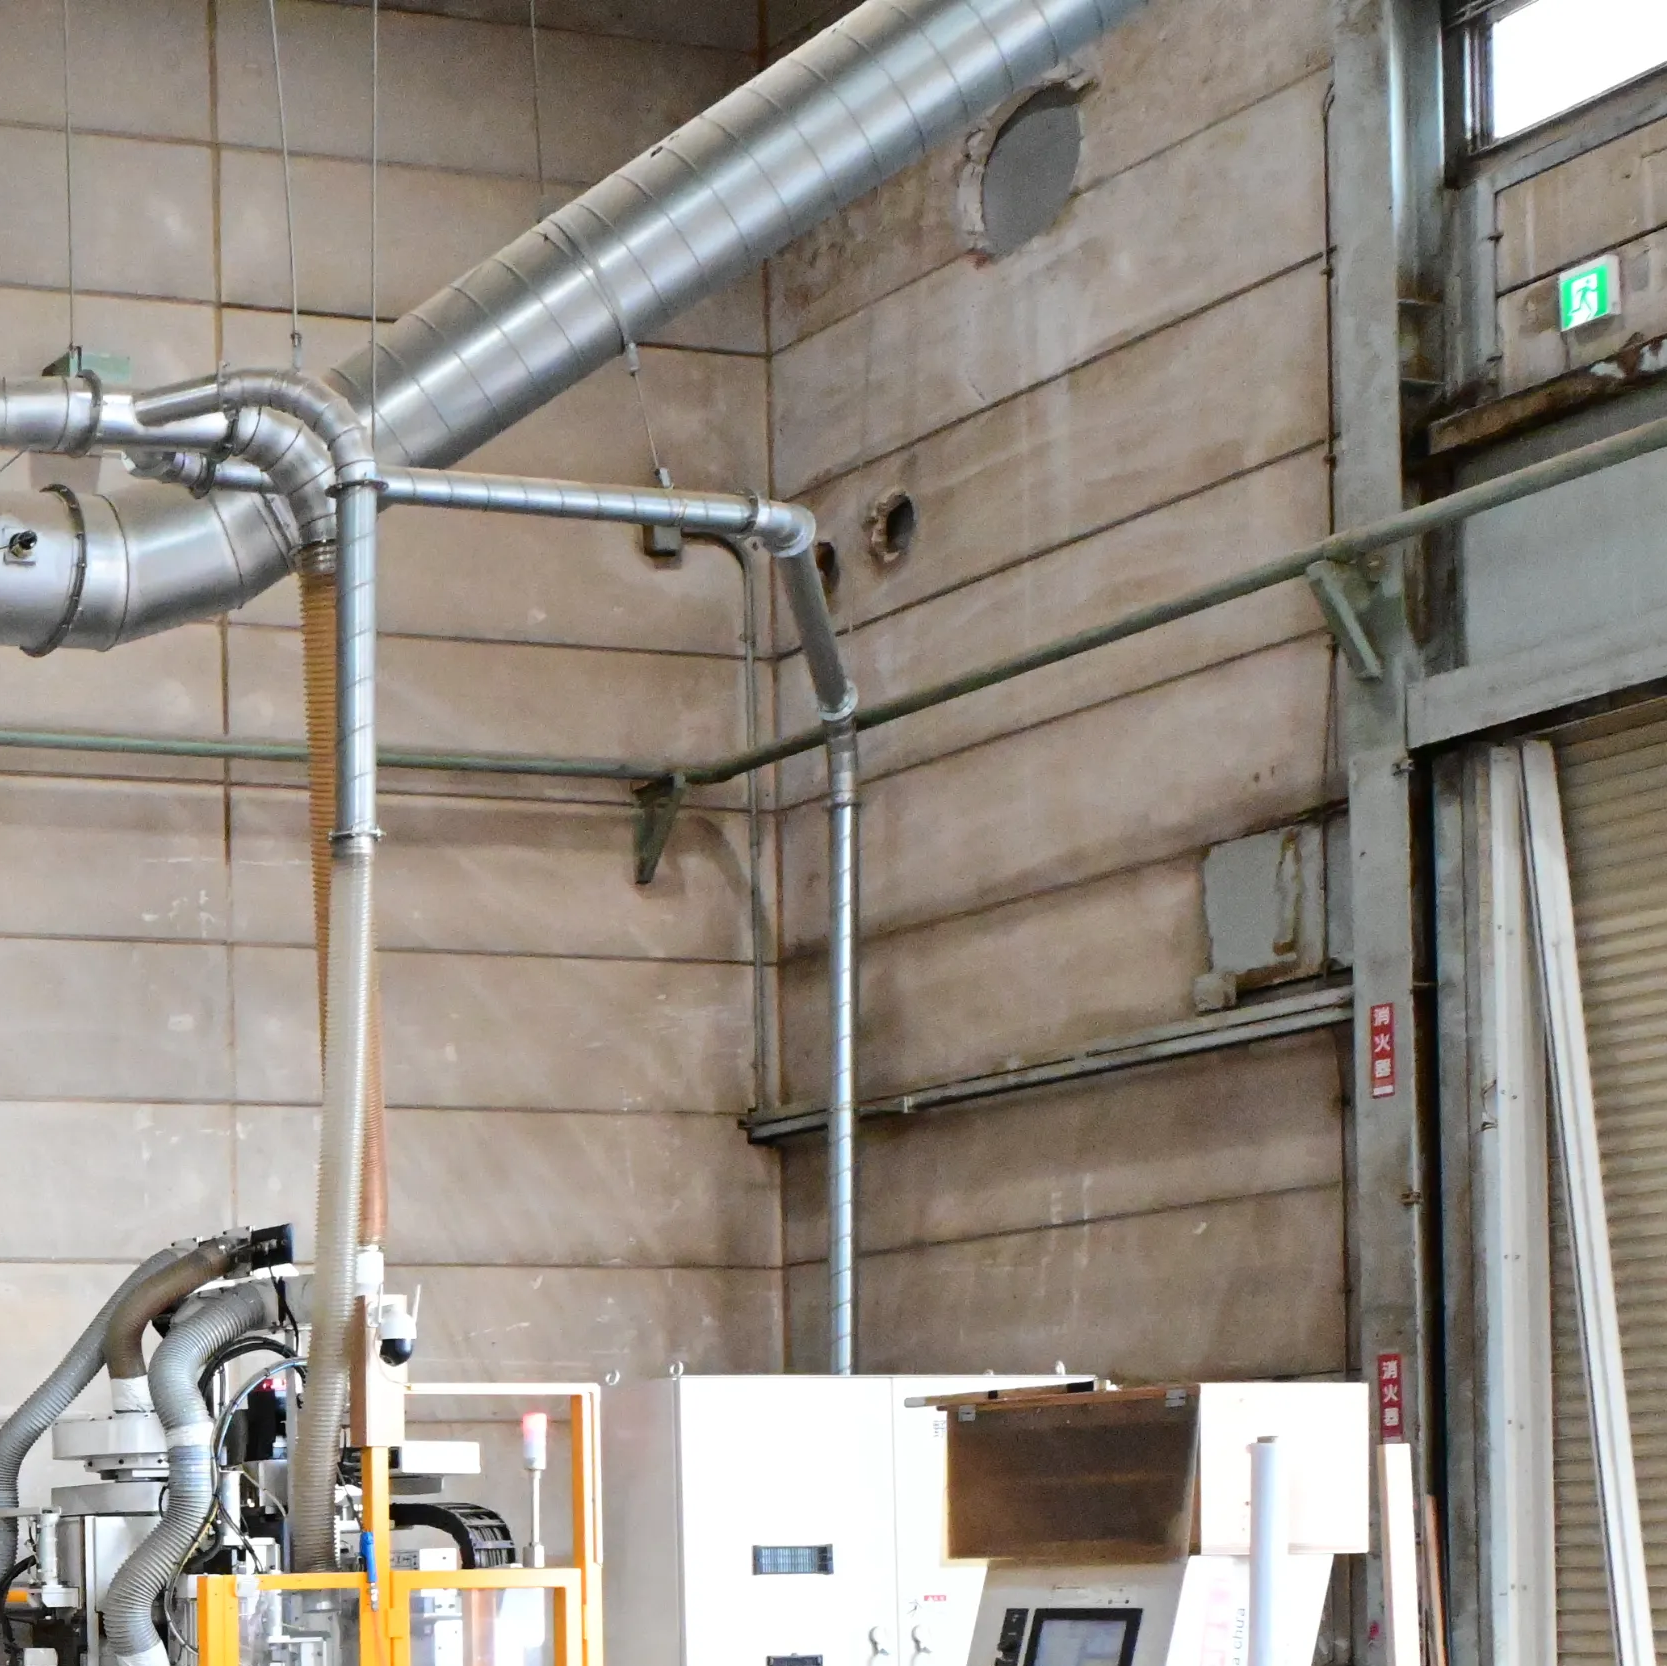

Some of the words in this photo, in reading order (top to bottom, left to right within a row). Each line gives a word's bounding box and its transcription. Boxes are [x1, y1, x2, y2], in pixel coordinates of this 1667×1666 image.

[1373, 1006, 1392, 1079] 消火器
[1381, 1359, 1399, 1426] 消火器
